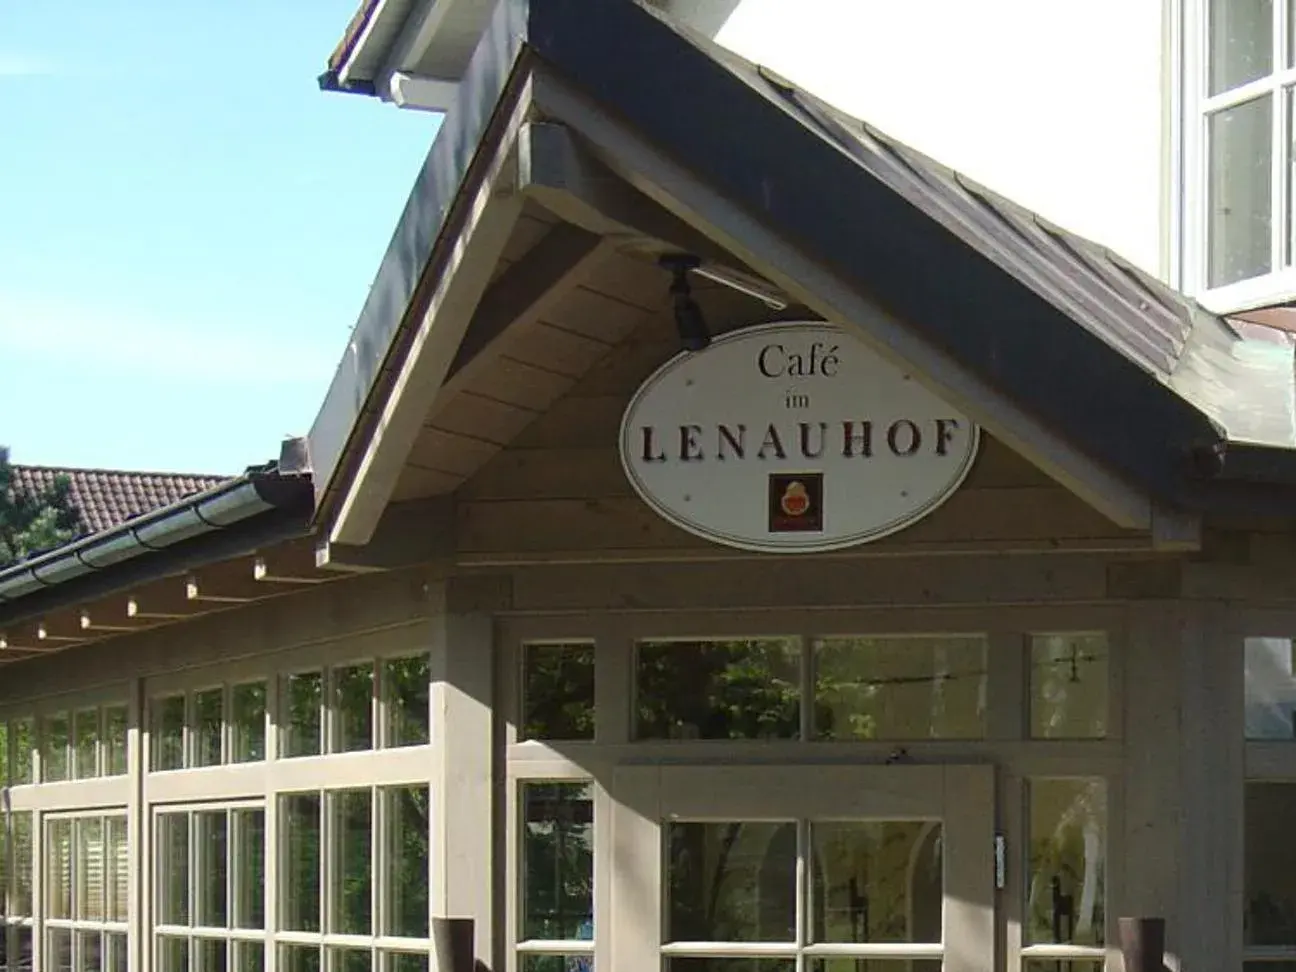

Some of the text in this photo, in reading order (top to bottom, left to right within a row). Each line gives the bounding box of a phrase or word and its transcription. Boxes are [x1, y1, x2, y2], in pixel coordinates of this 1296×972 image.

[758, 342, 840, 378] Café
[785, 389, 810, 409] im
[641, 418, 959, 463] LENAUHOF
